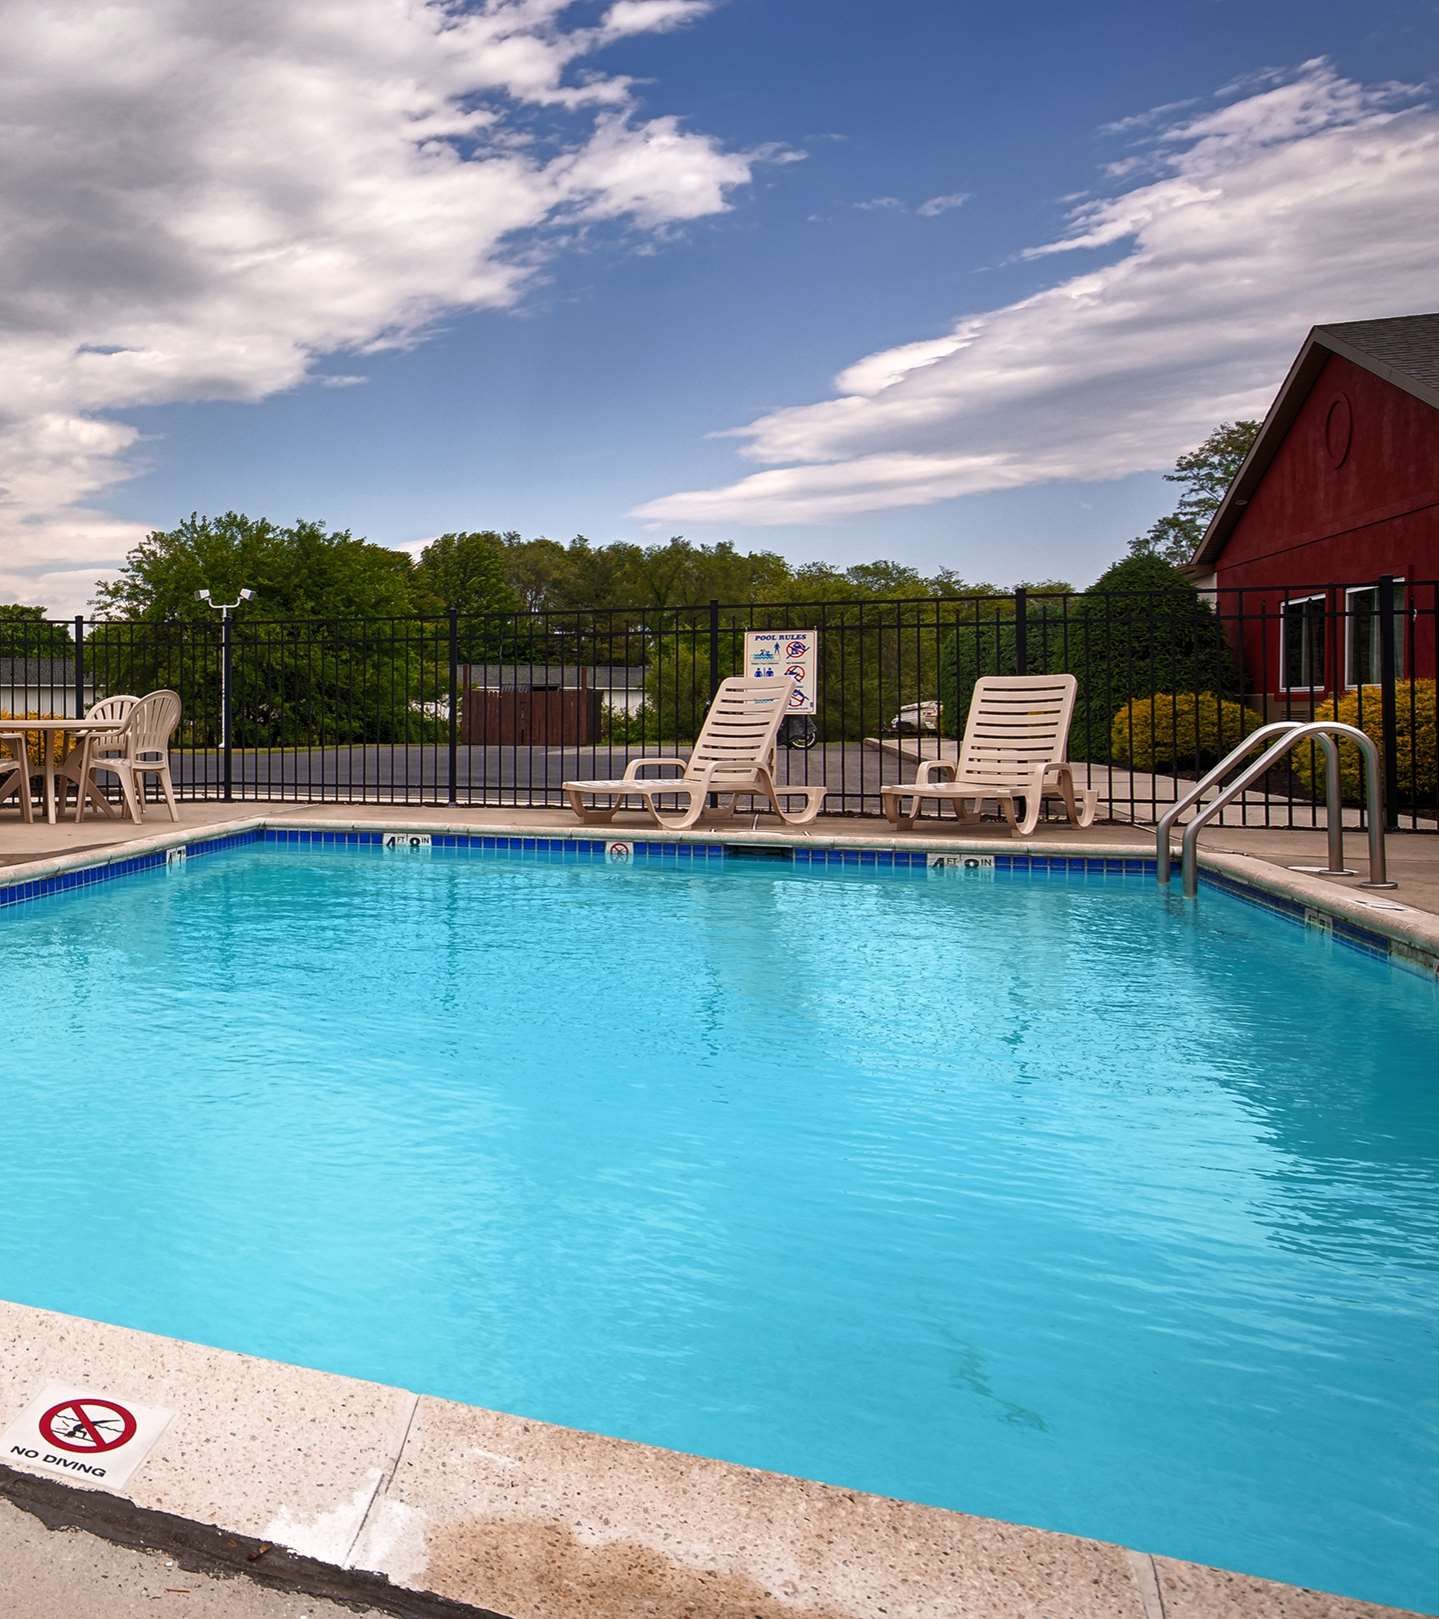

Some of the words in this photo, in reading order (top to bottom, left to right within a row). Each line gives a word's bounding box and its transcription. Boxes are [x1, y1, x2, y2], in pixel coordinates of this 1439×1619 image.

[946, 857, 958, 865] FT
[980, 858, 992, 867] IN
[10, 1445, 40, 1459] NO
[42, 1454, 107, 1478] DIVING
